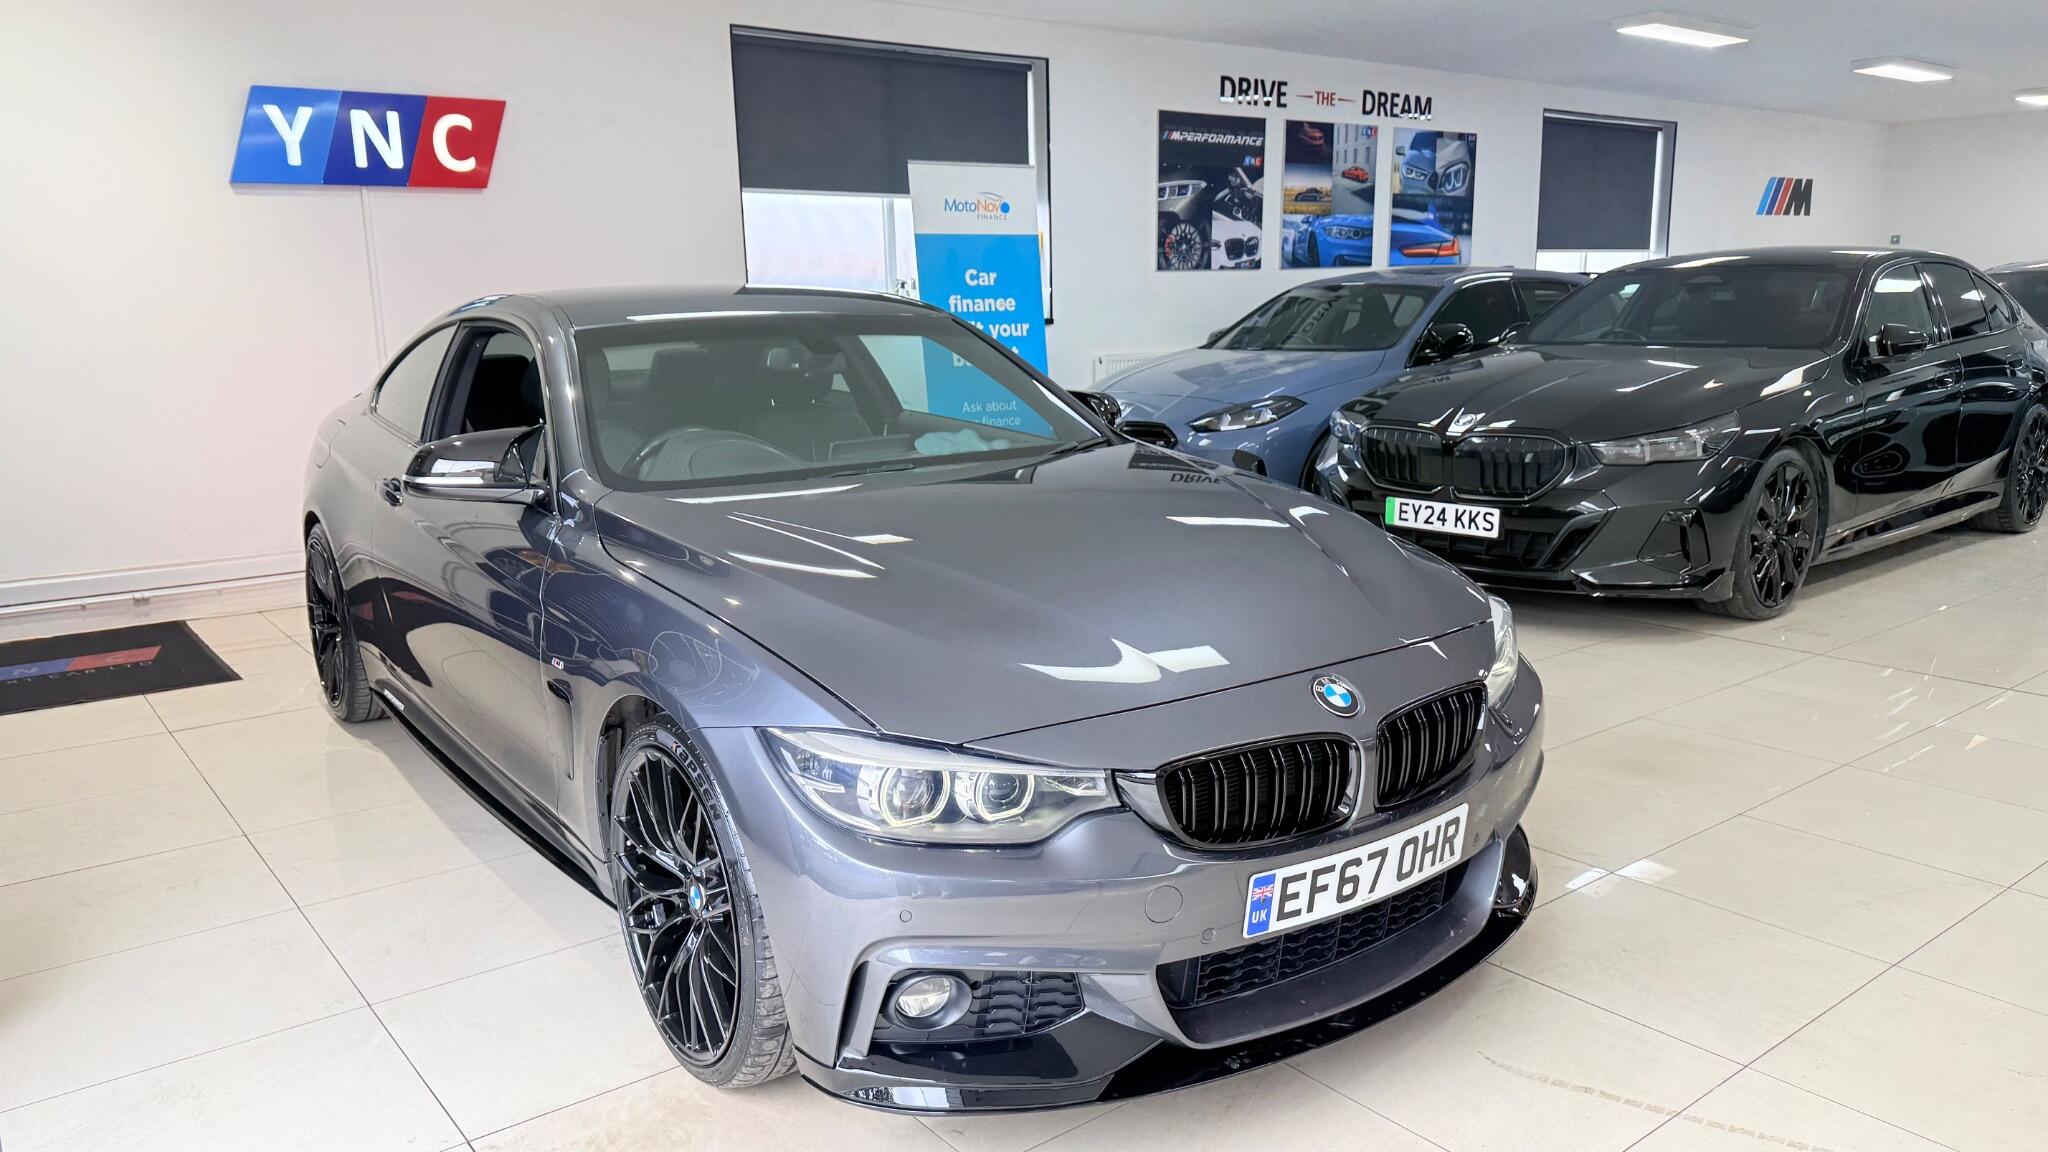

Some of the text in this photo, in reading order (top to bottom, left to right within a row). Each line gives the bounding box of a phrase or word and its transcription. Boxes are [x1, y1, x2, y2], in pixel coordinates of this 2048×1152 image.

[1219, 75, 1433, 121] DRIVE THE DREAM
[262, 103, 477, 173] YNC
[965, 269, 997, 286] Car
[948, 295, 1016, 313] finance
[988, 323, 1030, 339] your
[962, 400, 1017, 413] Ask about
[981, 416, 1021, 427] finance
[1398, 502, 1495, 532] EY24 KKS
[671, 740, 721, 820] KAPSEN
[1276, 816, 1461, 922] EF67 OHR
[1252, 908, 1268, 924] UK
